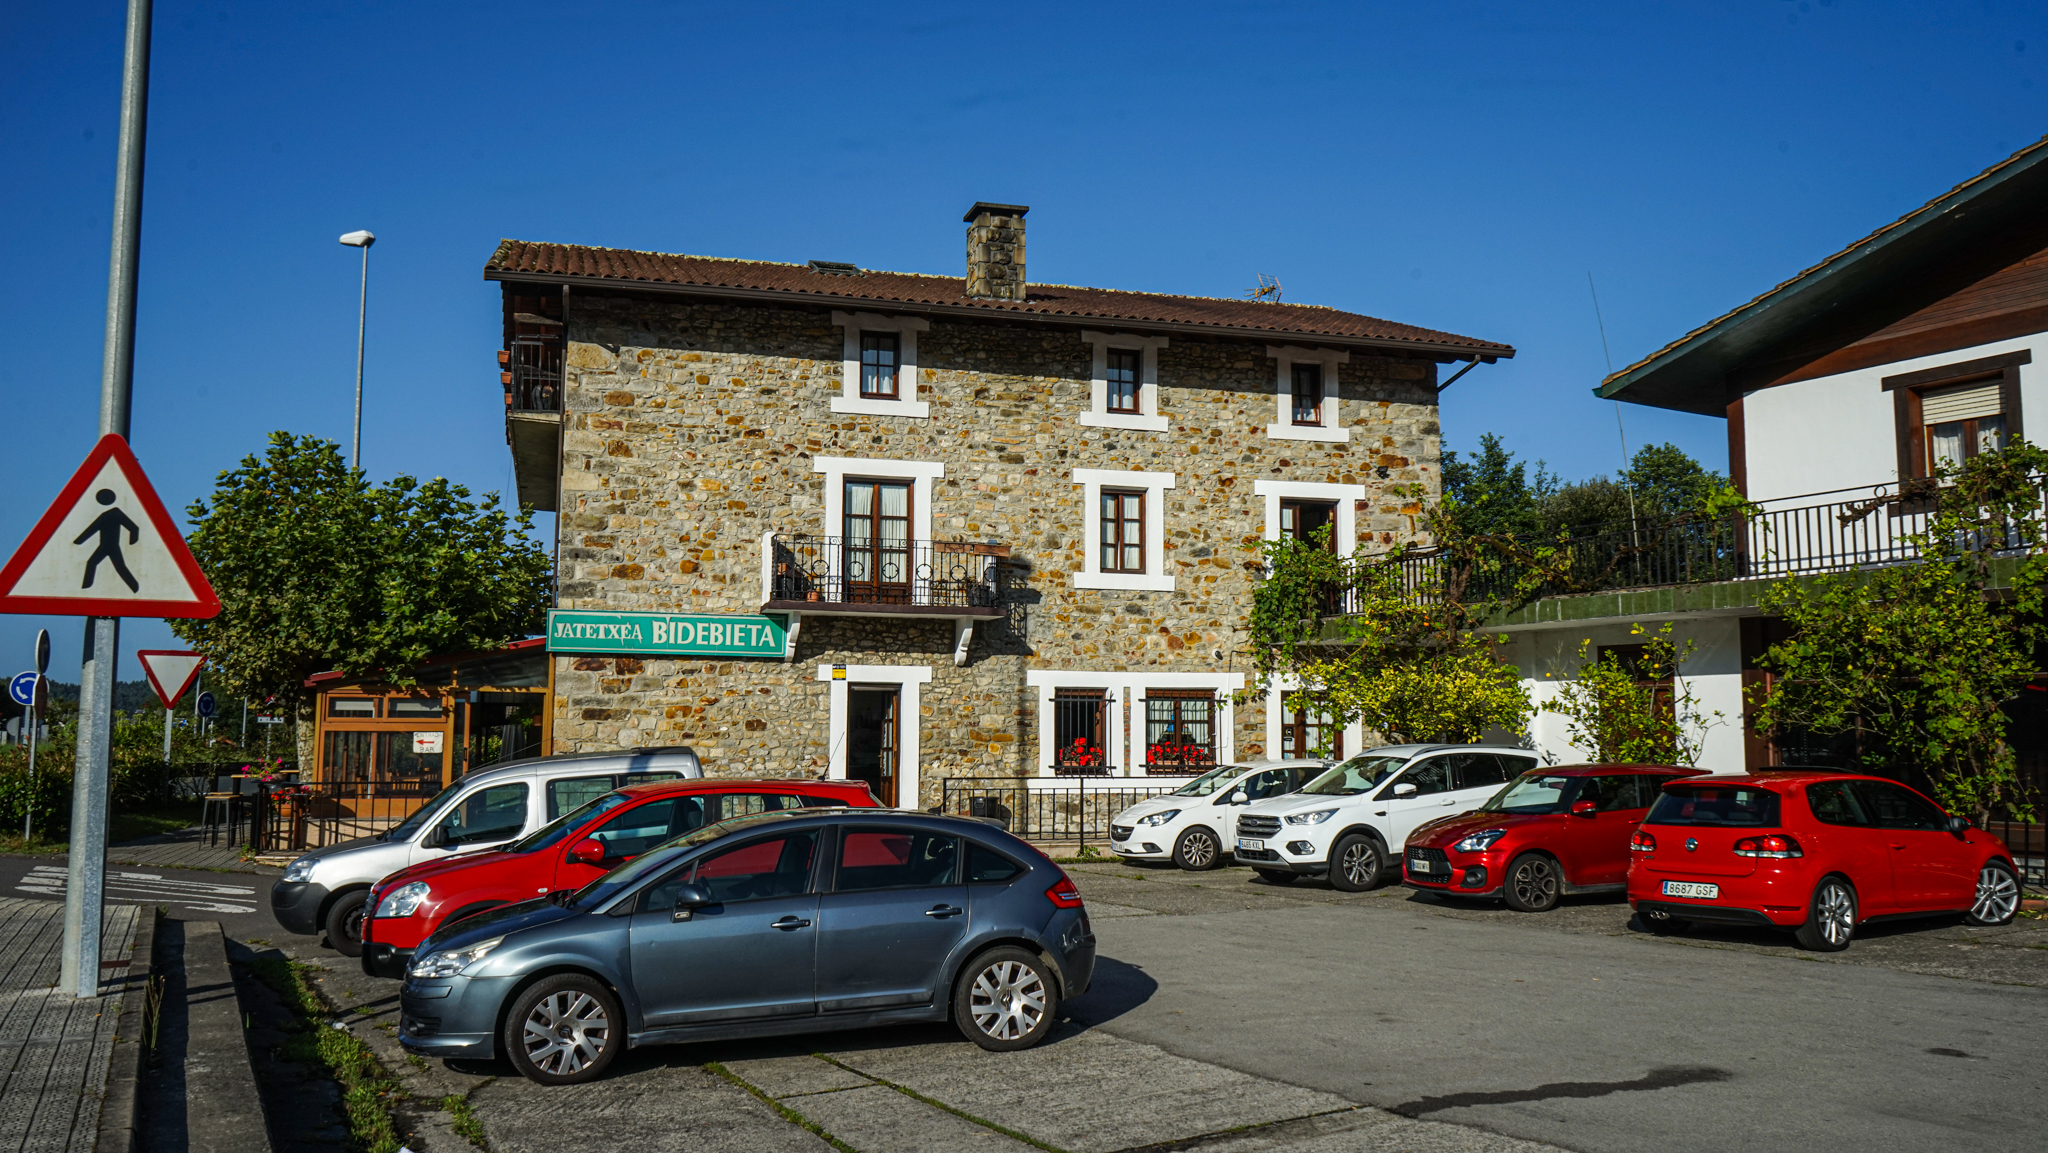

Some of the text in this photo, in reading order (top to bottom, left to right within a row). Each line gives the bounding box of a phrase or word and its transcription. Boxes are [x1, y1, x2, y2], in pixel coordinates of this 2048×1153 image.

[554, 620, 776, 648] JATETXEA BIDEBIETA
[1669, 883, 1715, 897] 8687 GSF
